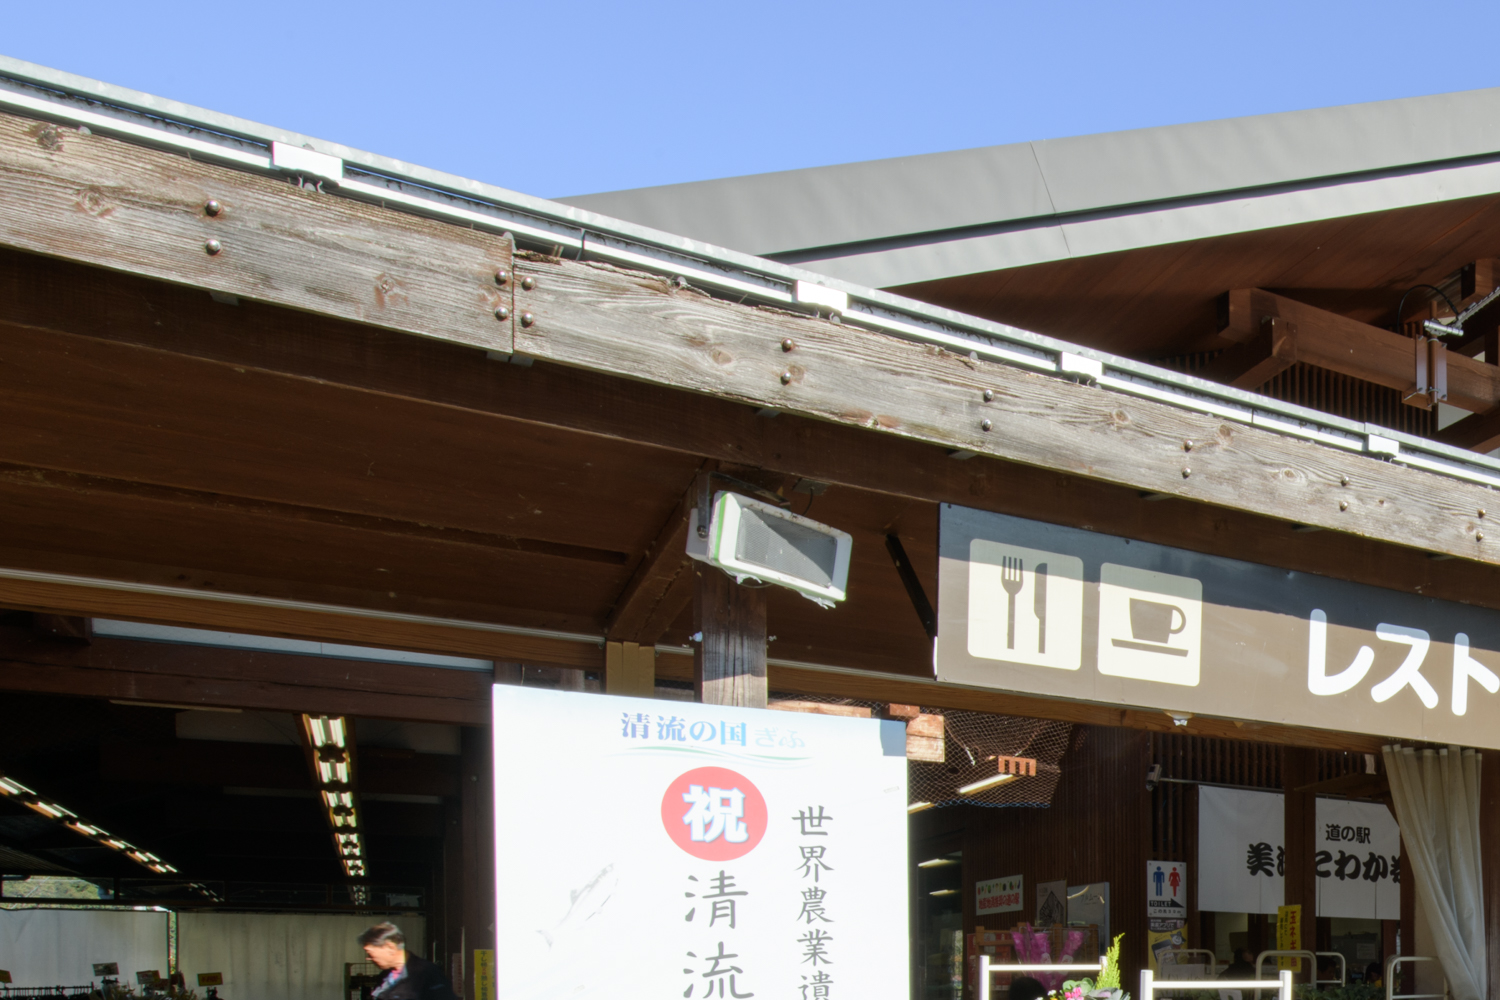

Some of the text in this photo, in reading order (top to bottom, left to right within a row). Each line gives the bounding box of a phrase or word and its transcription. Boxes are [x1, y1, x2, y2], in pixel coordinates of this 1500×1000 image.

[682, 784, 749, 843] 祝
[1326, 824, 1371, 844] 道の駅
